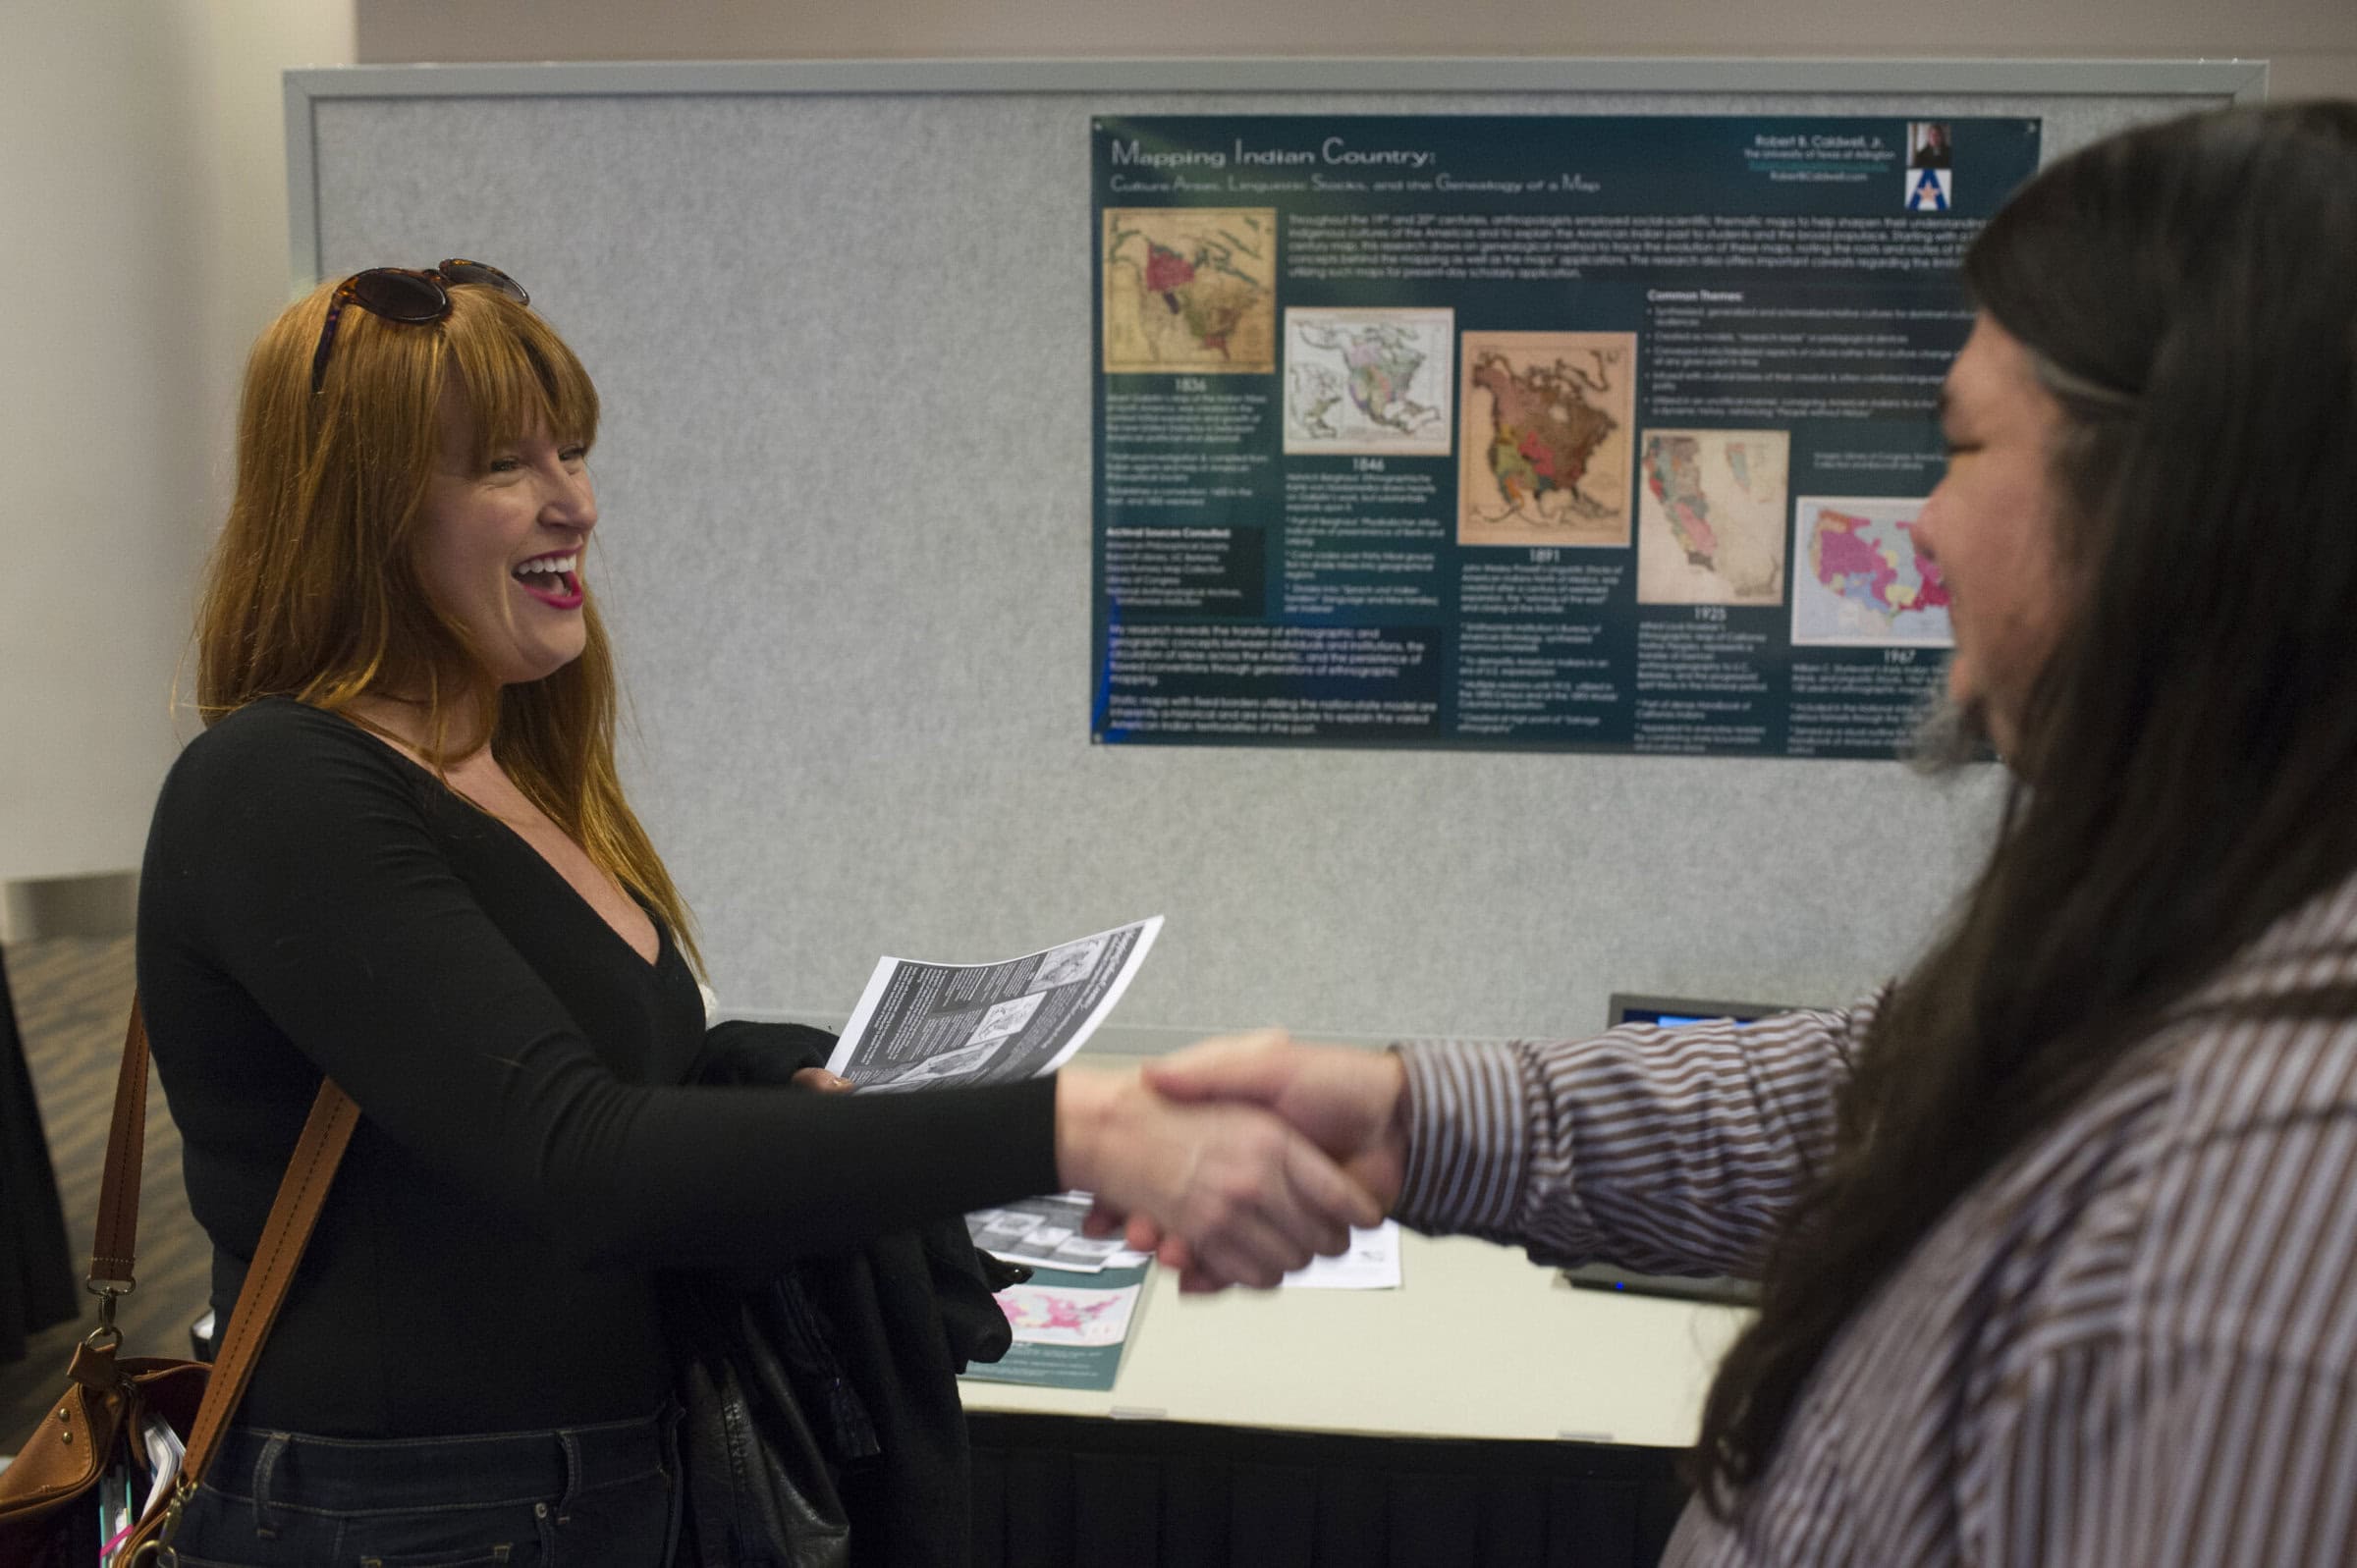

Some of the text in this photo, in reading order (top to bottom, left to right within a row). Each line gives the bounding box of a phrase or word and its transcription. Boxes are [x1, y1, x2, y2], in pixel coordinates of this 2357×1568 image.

[1755, 135, 1795, 147] Robert
[1111, 136, 1436, 169] Mapping Indian Country:
[1372, 179, 1403, 191] and
[1406, 179, 1433, 191] the
[1435, 173, 1522, 193] Genealogy
[1526, 179, 1545, 191] of
[1562, 173, 1601, 193] Map
[1647, 289, 1698, 301] Common
[1695, 607, 1727, 622] 1925
